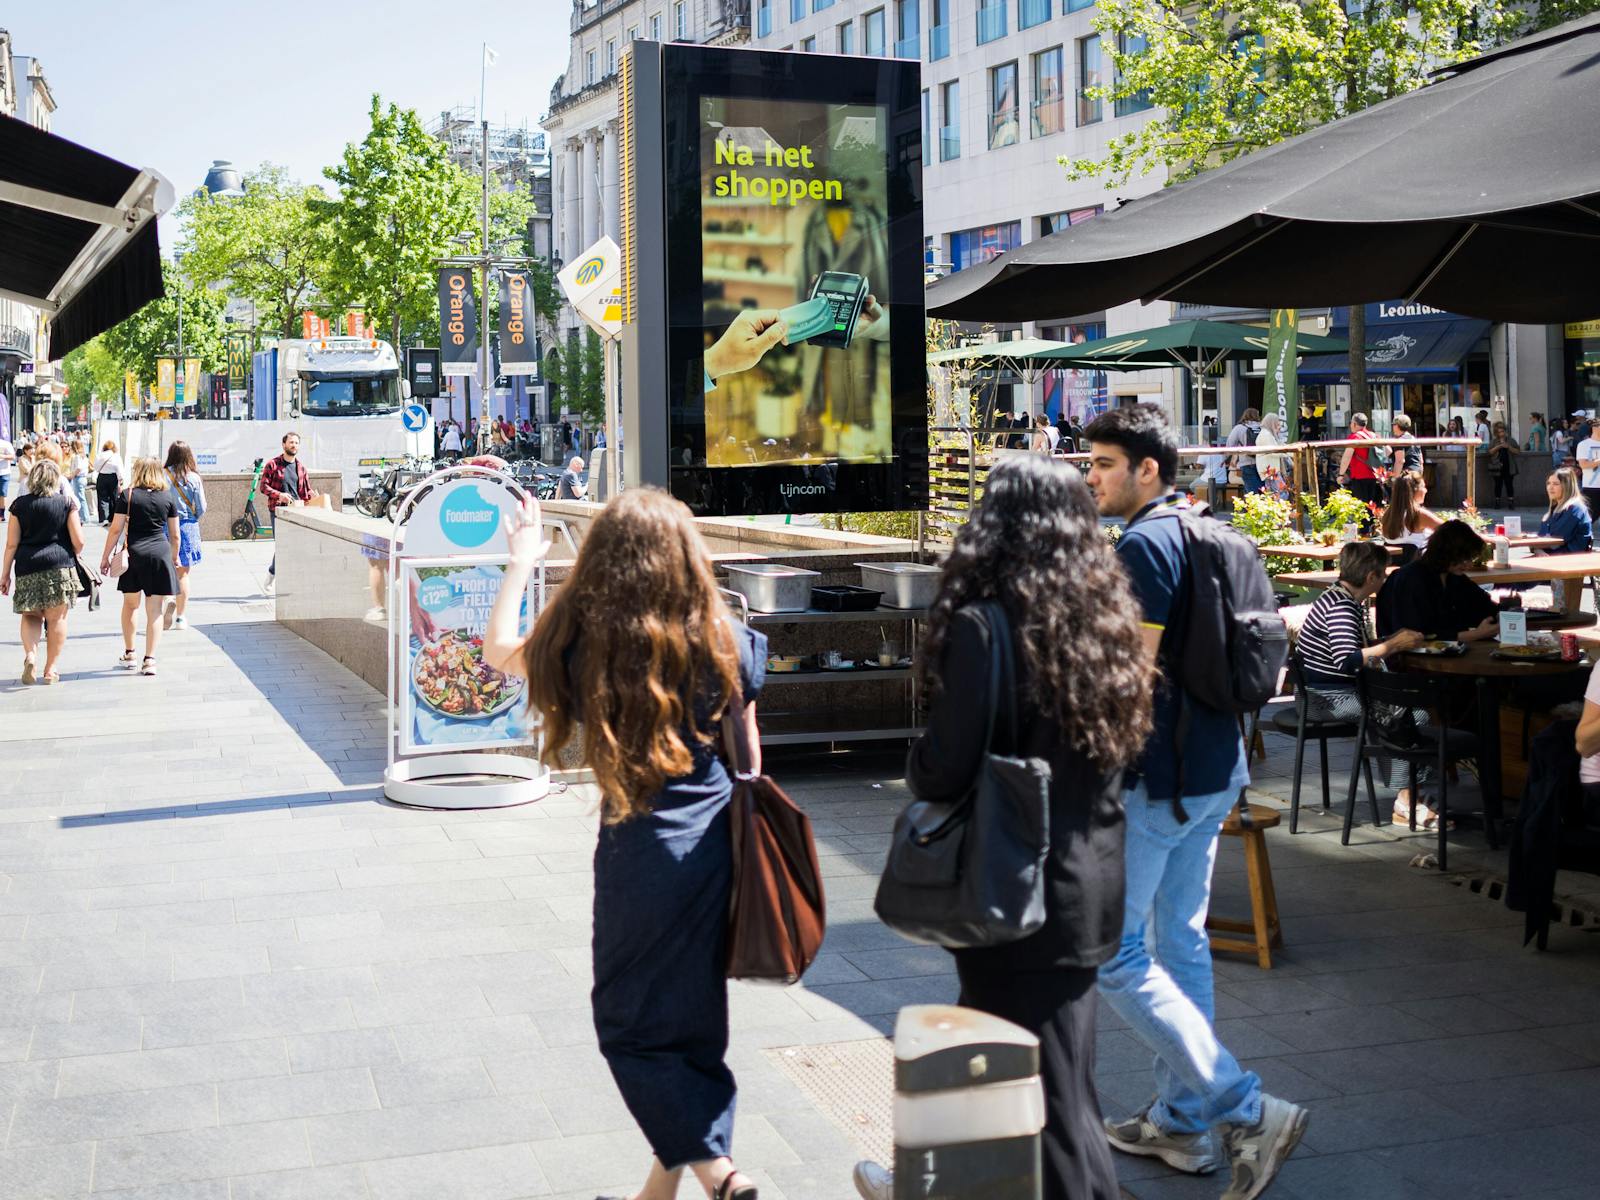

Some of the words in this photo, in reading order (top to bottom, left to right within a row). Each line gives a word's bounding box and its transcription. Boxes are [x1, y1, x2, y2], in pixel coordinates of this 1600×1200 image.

[715, 138, 755, 166] Na
[765, 139, 814, 168] het
[715, 169, 842, 206] shoppen
[448, 275, 466, 345] Orange
[507, 275, 526, 345] Orange
[1379, 302, 1447, 318] Leonid
[1275, 339, 1289, 443] McDonal
[780, 483, 826, 498] Lijncom
[446, 509, 494, 523] Foodmaker
[455, 579, 484, 592] FROM
[463, 592, 496, 607] FIELD
[460, 607, 475, 621] TO
[477, 606, 492, 620] YO
[466, 621, 488, 636] TAB
